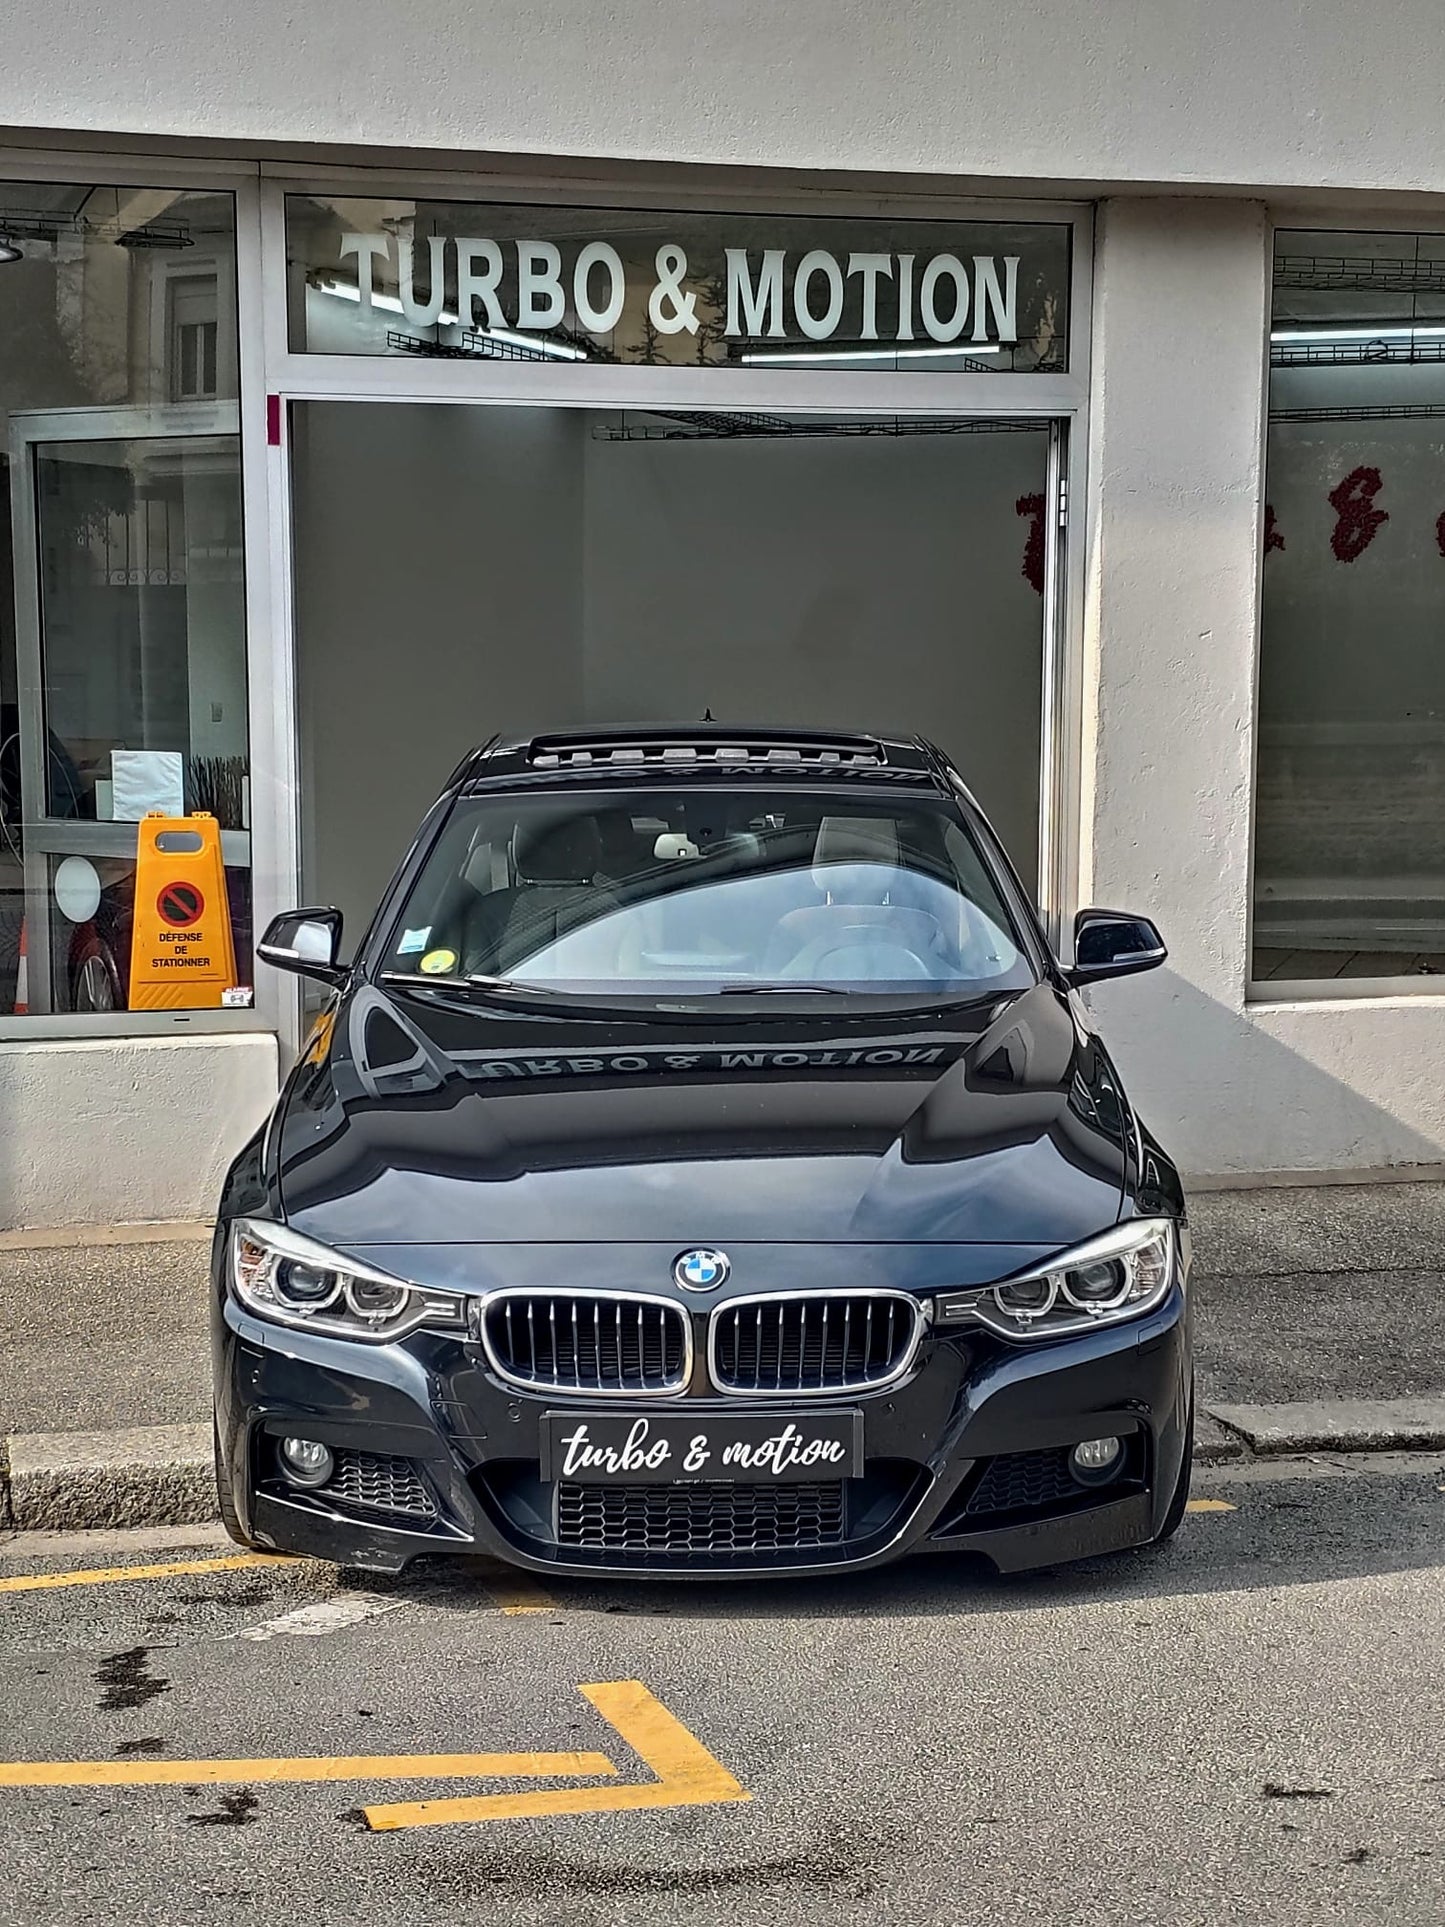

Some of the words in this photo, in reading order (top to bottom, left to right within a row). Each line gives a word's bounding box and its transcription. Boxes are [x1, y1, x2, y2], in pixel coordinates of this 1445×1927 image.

[338, 233, 625, 334] TURBO
[648, 243, 701, 336] &
[724, 247, 1021, 342] MOTION
[159, 931, 202, 942] DÉFENSE
[174, 945, 188, 955] DE
[152, 957, 210, 968] STATIONNER
[560, 1418, 672, 1476] turbo
[682, 1435, 711, 1472] &
[722, 1423, 846, 1475] motion
